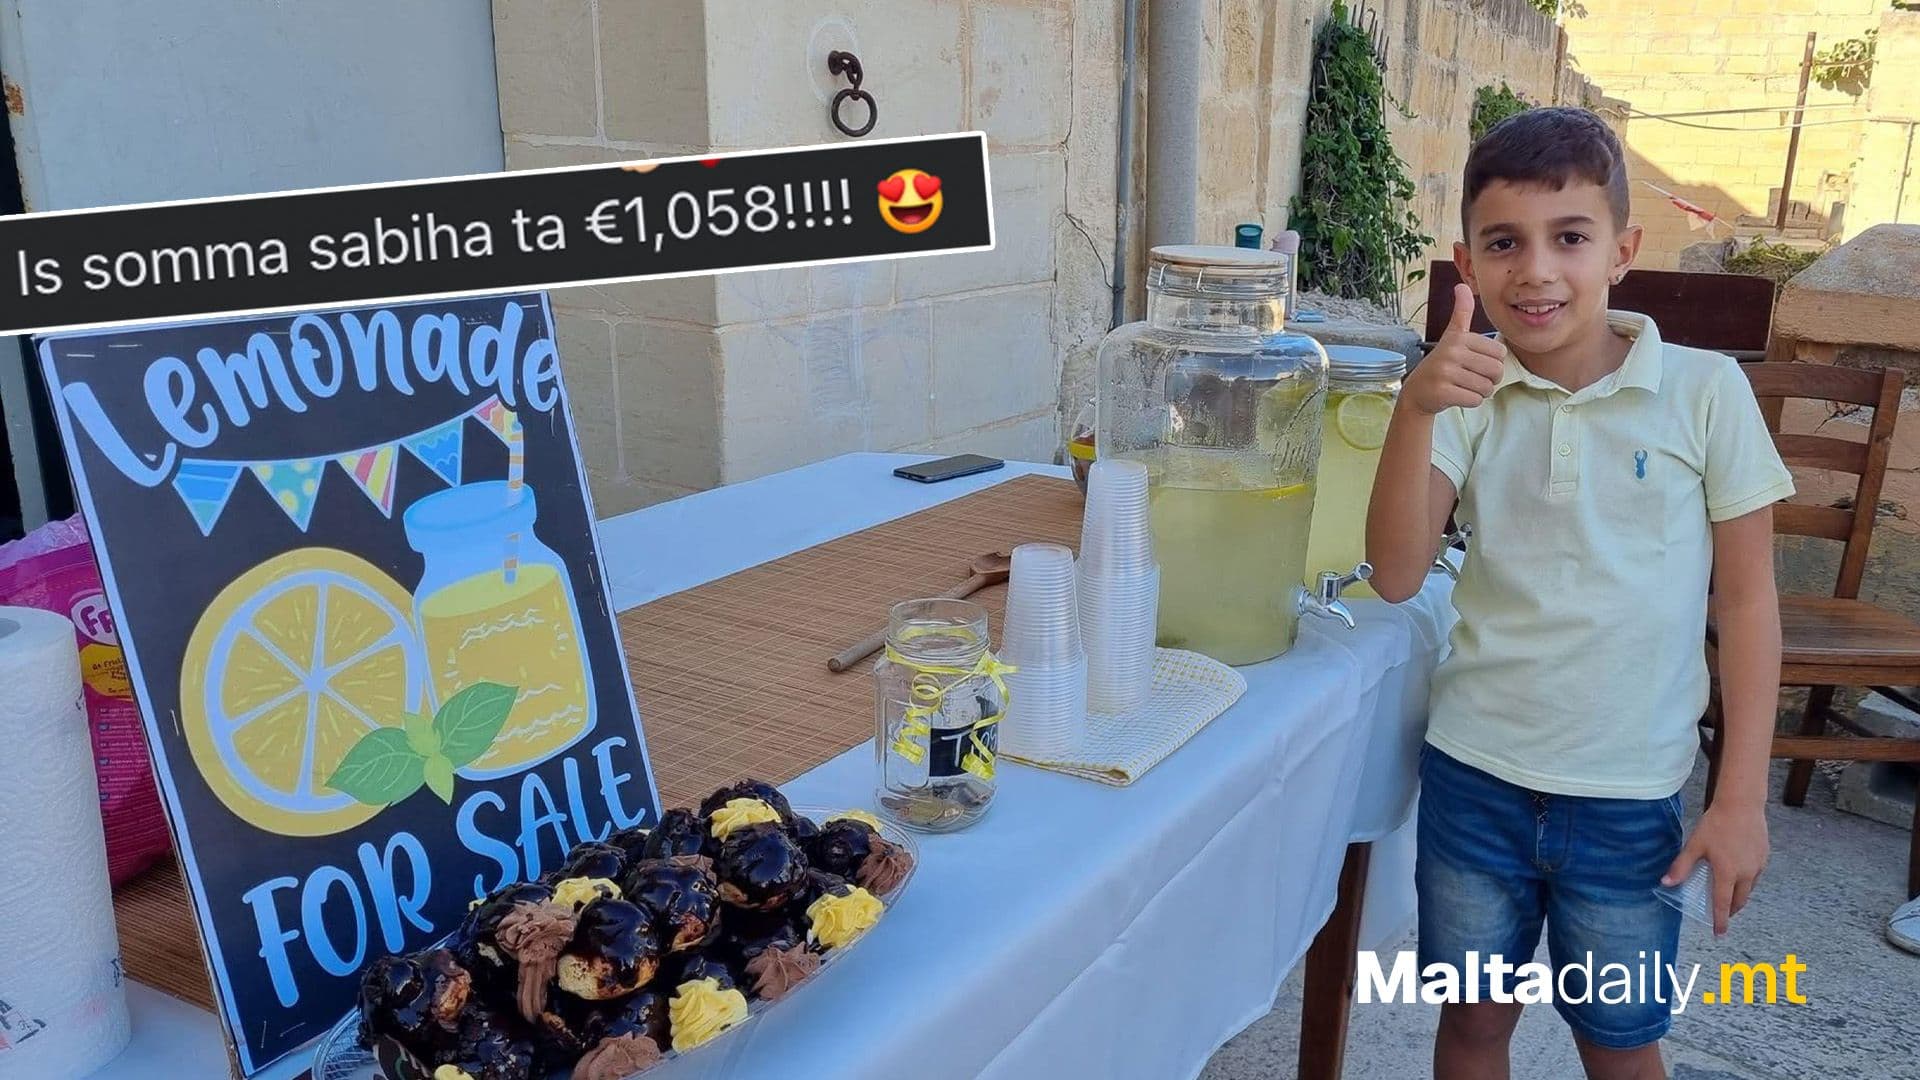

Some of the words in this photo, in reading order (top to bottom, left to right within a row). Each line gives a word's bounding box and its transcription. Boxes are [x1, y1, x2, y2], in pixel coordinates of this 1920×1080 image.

[62, 301, 563, 487] Lemonade
[242, 831, 434, 1009] FOR
[455, 736, 646, 900] SALE
